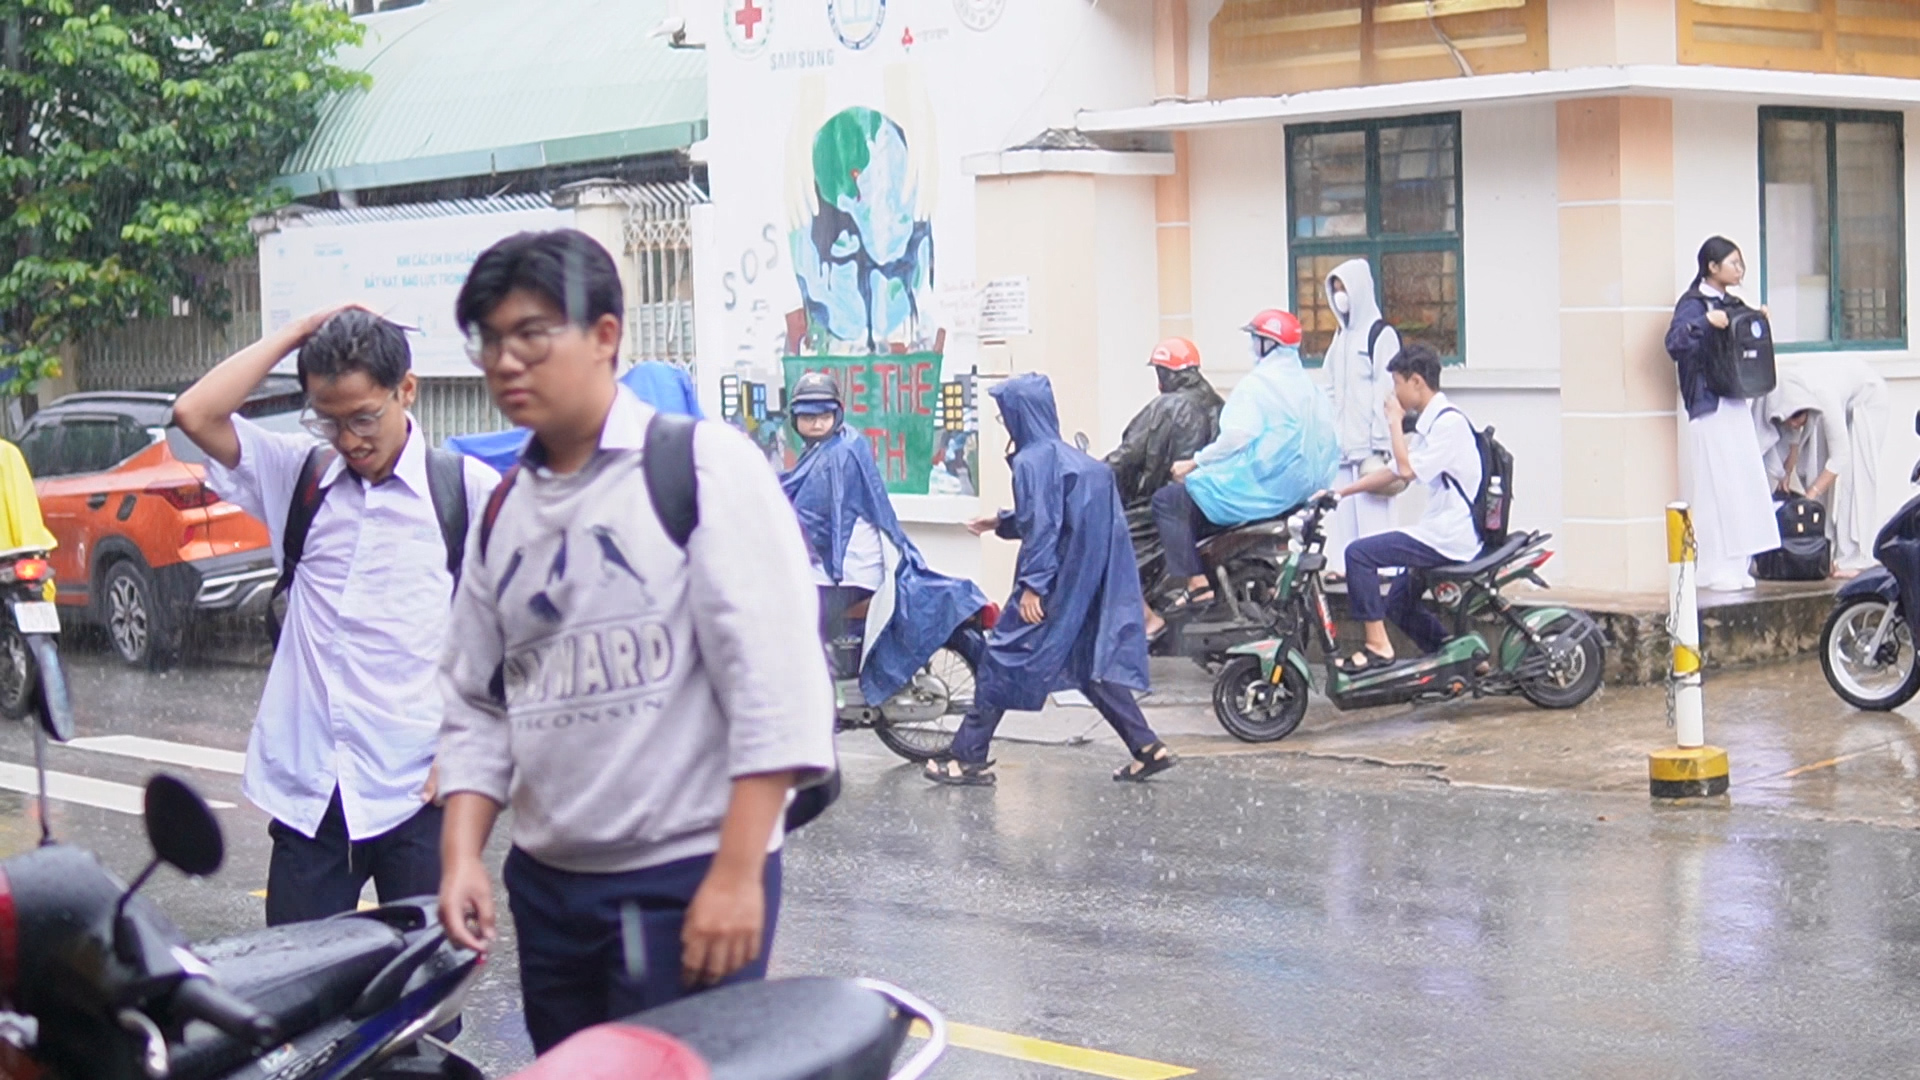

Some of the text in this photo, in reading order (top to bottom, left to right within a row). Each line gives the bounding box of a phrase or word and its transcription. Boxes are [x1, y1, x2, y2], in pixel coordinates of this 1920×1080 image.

[769, 48, 835, 71] SAMSUNG
[722, 223, 779, 311] SOS
[873, 361, 933, 415] THE
